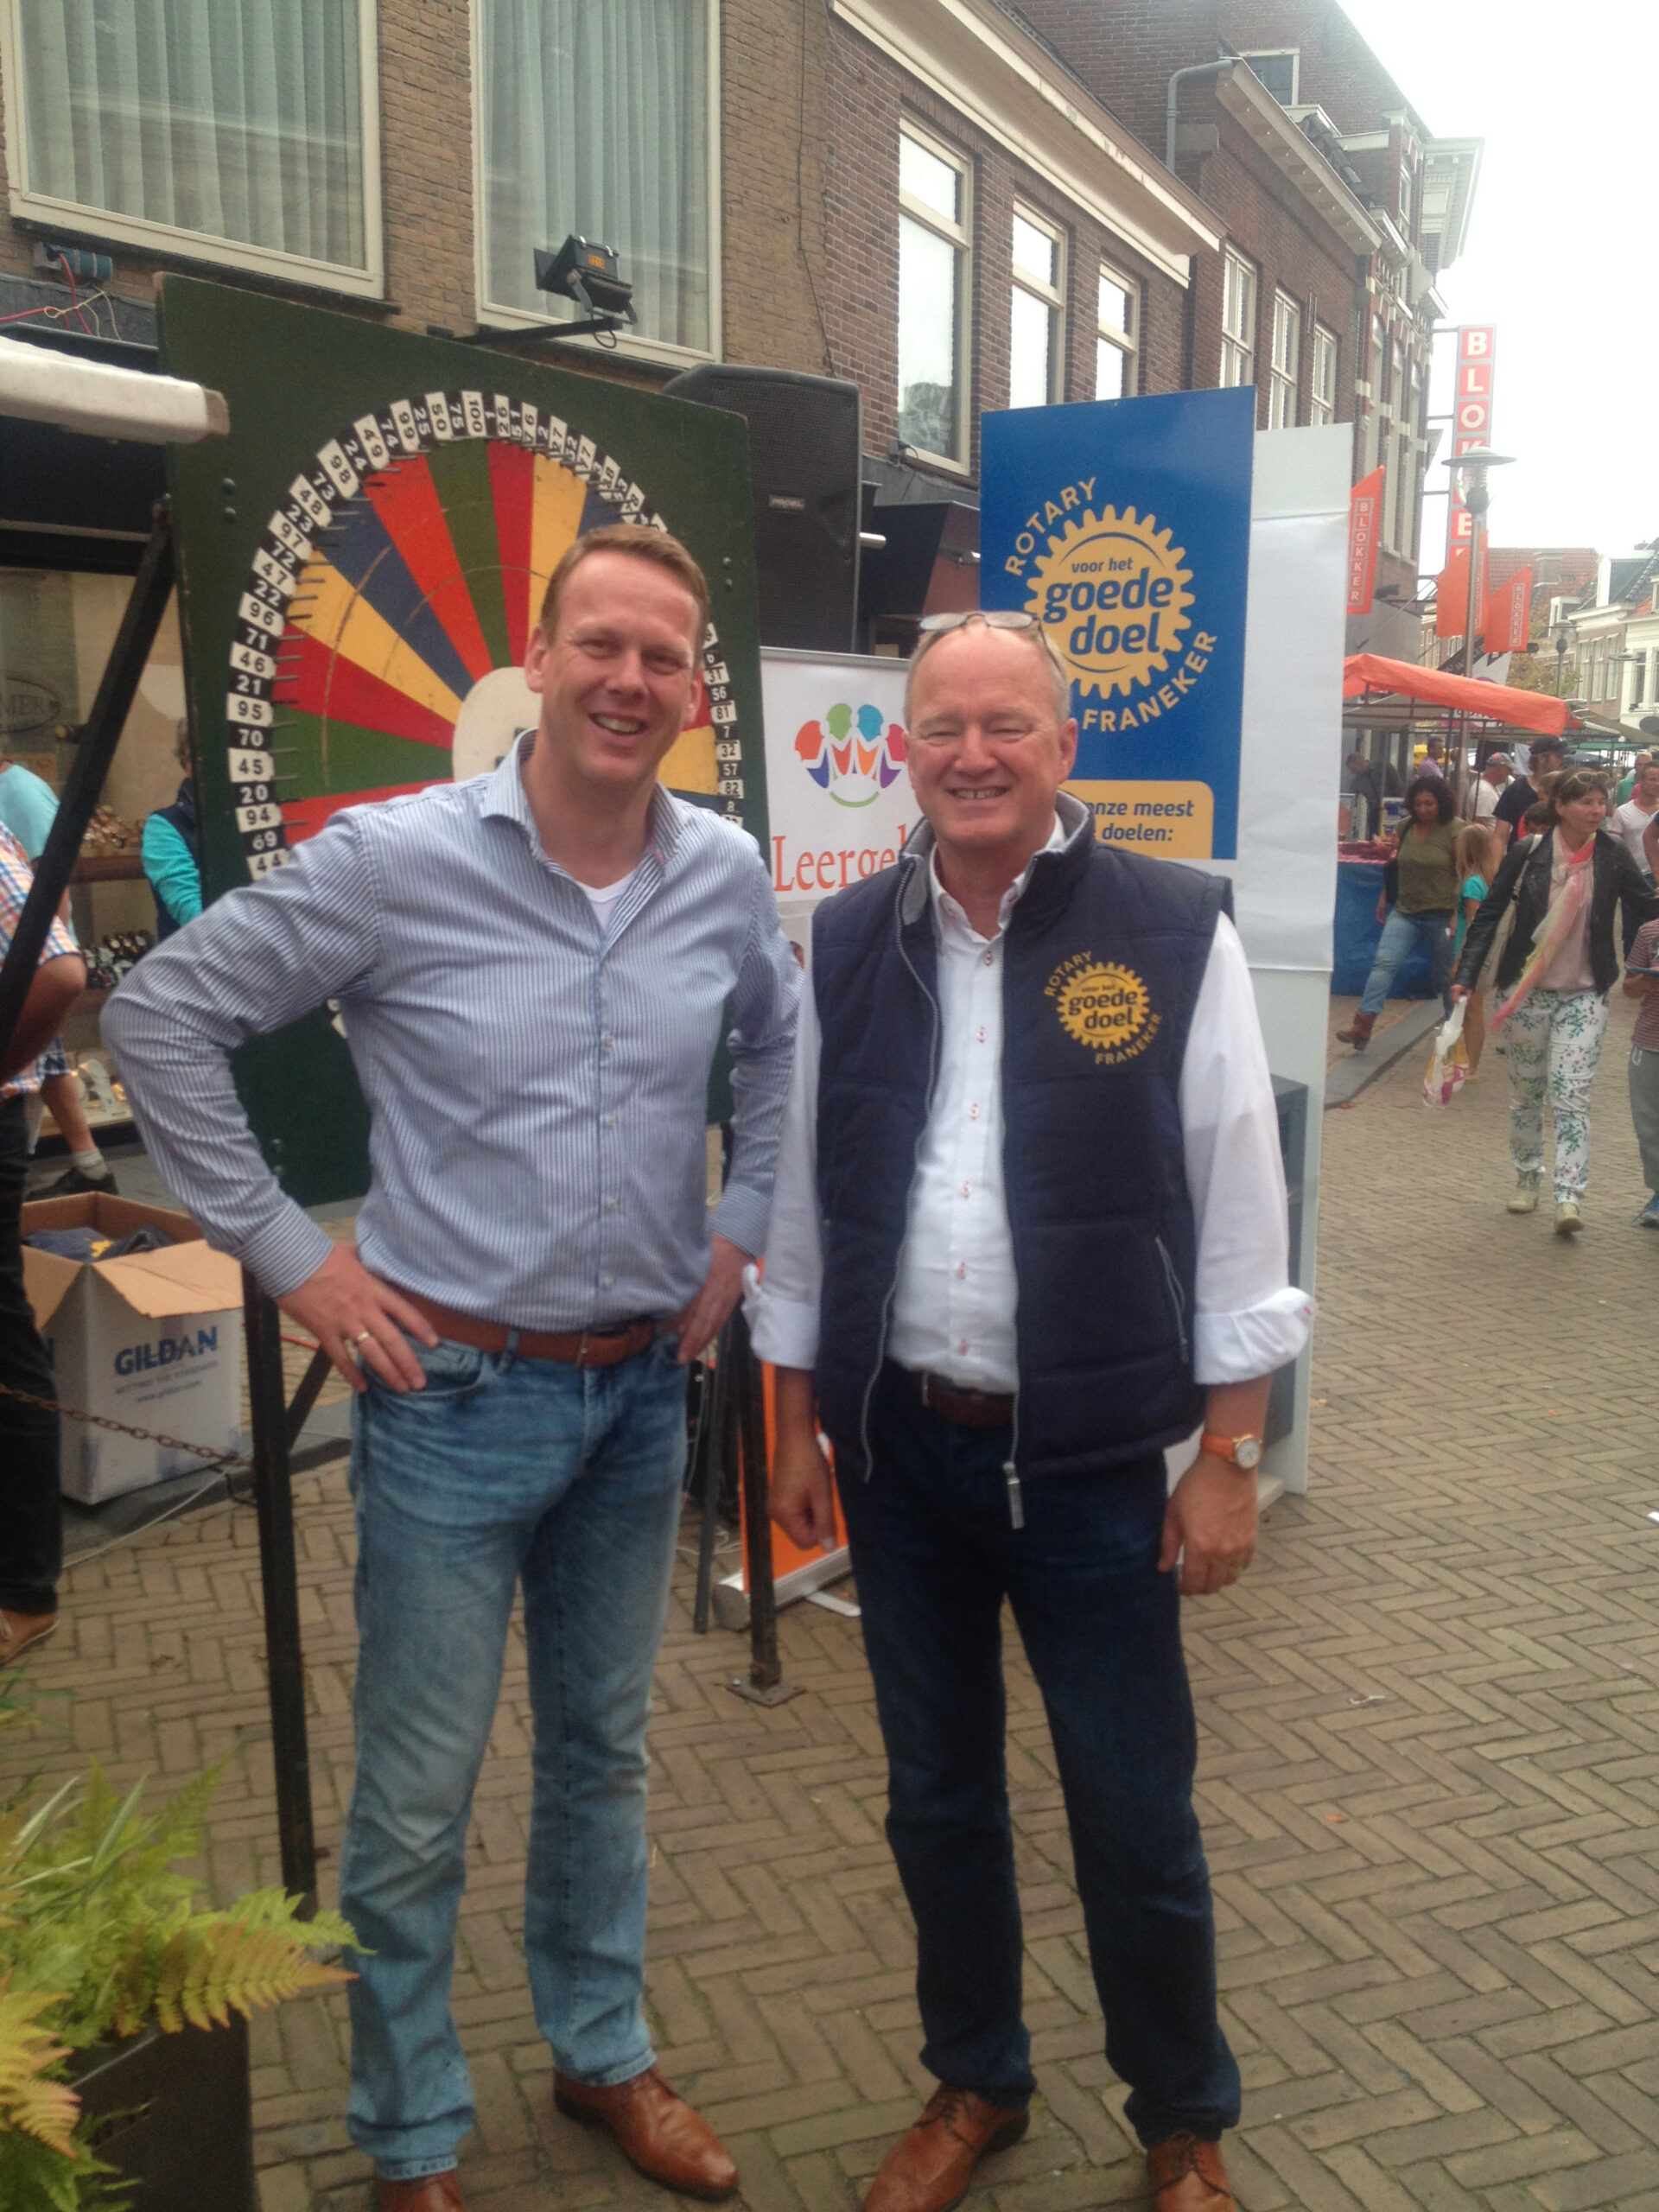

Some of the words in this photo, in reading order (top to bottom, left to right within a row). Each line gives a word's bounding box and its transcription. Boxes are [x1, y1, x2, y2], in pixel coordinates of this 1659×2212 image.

[399, 412, 414, 439] 99
[413, 407, 431, 435] 25
[432, 404, 447, 432] 50
[450, 403, 465, 429] 75
[468, 399, 483, 432] 100
[485, 410, 495, 419] 1
[364, 429, 383, 457] 49
[381, 418, 398, 448] 74
[537, 426, 550, 440] 2
[1456, 330, 1487, 557] BLOE
[345, 440, 367, 470] 24
[330, 455, 350, 484] 98
[313, 472, 335, 500] 73
[301, 491, 322, 515] 48
[286, 504, 313, 532] 23
[1005, 477, 1096, 576] ROTARY
[282, 523, 302, 546] 97
[272, 541, 296, 569] 72
[1351, 502, 1369, 601] BLOKKER
[262, 562, 287, 585] 47
[1071, 560, 1104, 573] voor
[1108, 556, 1133, 572] het
[254, 580, 281, 606] 22
[1042, 567, 1174, 623] goede
[250, 602, 275, 626] 96
[247, 627, 267, 650] 71
[1070, 612, 1160, 655] doel
[240, 652, 265, 673] 46
[237, 675, 262, 695] 21
[1083, 629, 1217, 733] FRANEKER
[711, 685, 727, 701] 56
[238, 700, 263, 720] 95
[716, 705, 730, 720] 81
[239, 728, 264, 747] 70
[723, 726, 730, 738] 7
[721, 744, 736, 758] 32
[239, 759, 263, 775] 45
[723, 763, 738, 776] 57
[240, 785, 269, 804] 20
[725, 781, 739, 794] 82
[246, 807, 270, 825] 94
[728, 800, 735, 812] 8
[1134, 800, 1195, 817] meest
[252, 830, 277, 851] 69
[1102, 823, 1173, 841] doelen:
[257, 854, 282, 872] 44
[1044, 950, 1092, 997] ROTARY
[1068, 988, 1138, 1016] goede
[1084, 1007, 1134, 1029] doel
[1095, 1013, 1162, 1065] FRANEKER
[114, 1325, 218, 1376] GILDAN
